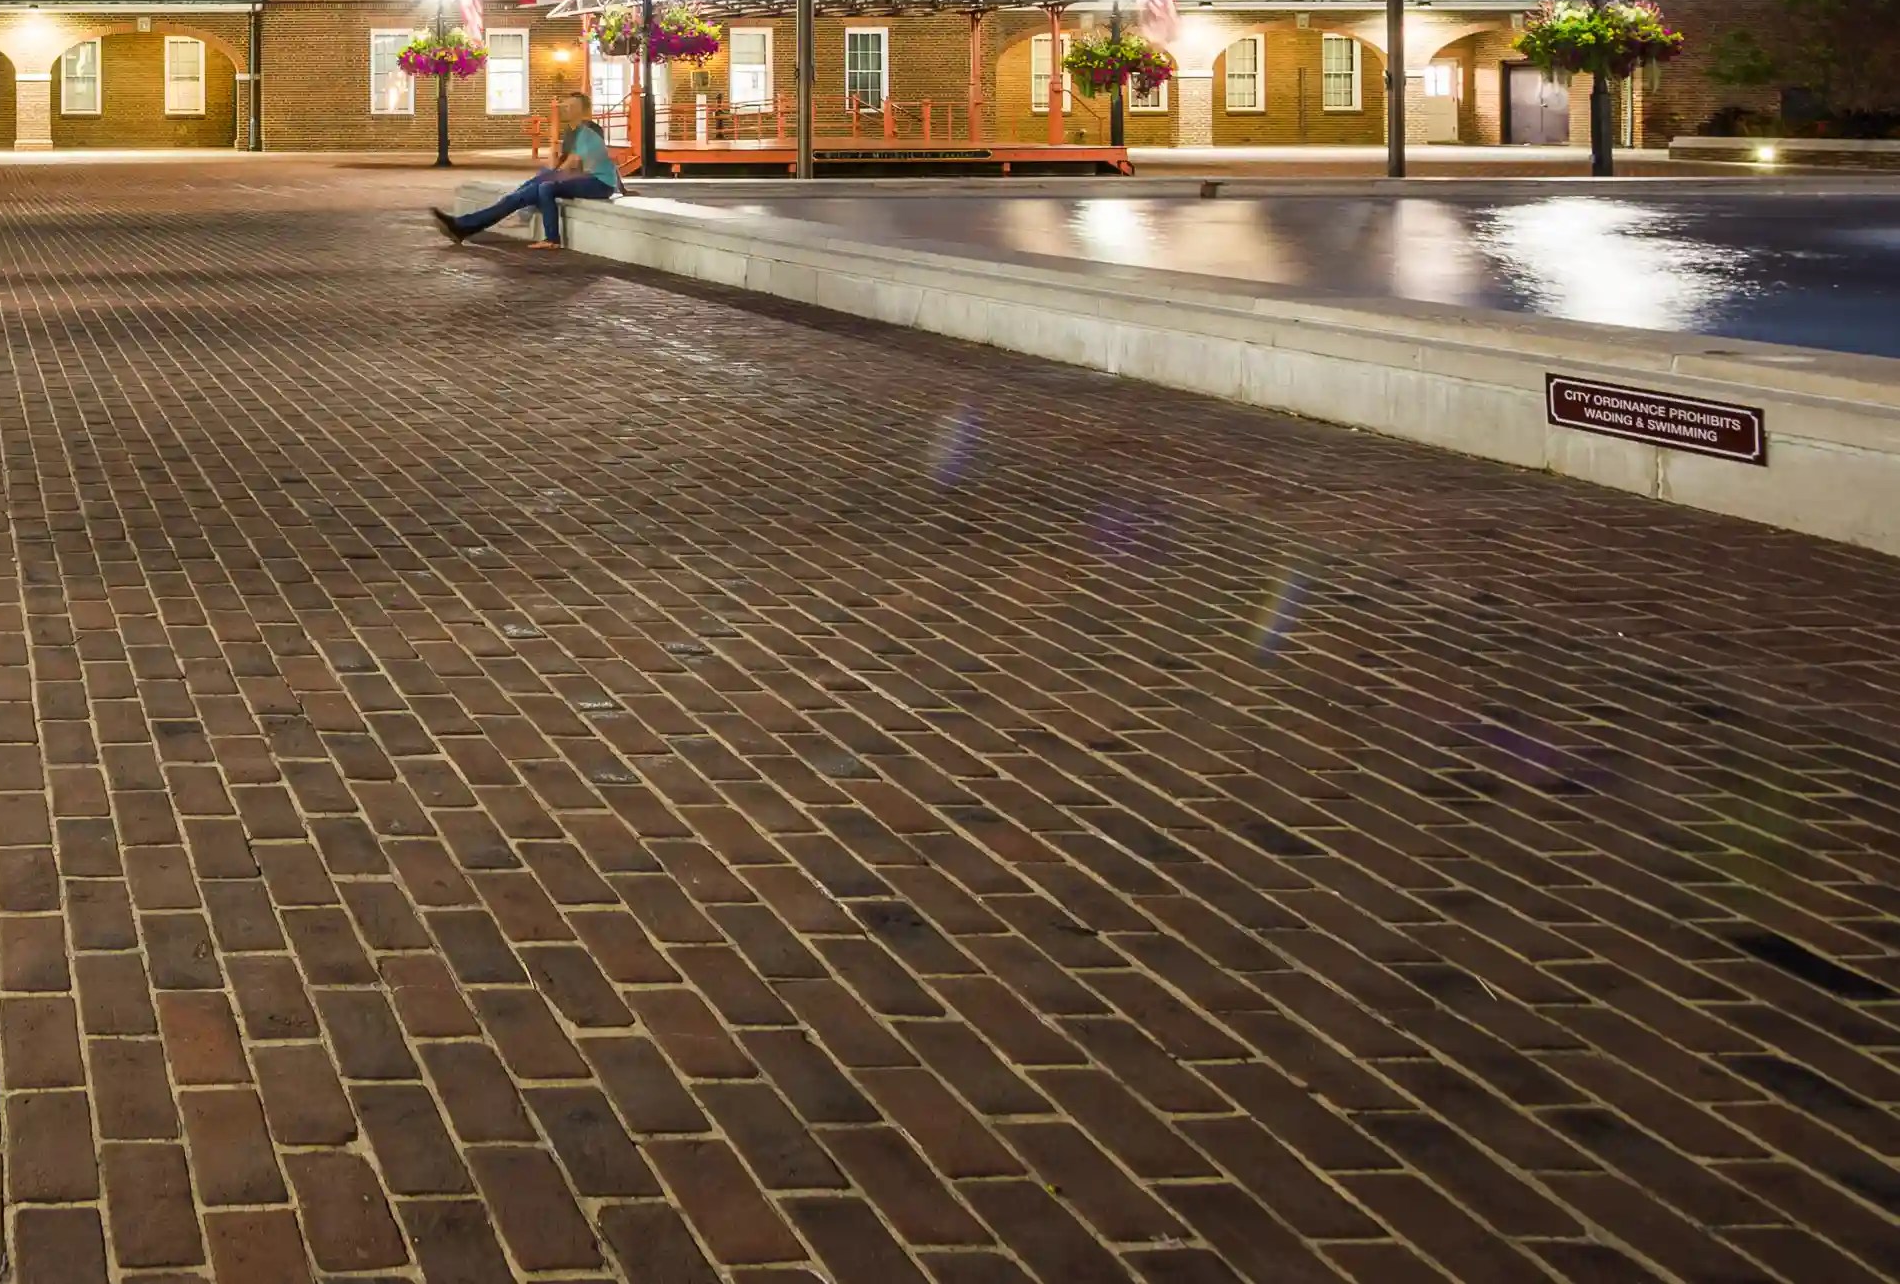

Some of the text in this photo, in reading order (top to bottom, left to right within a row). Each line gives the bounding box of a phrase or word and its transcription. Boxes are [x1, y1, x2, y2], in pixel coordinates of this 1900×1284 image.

[1564, 389, 1741, 431] CITY ORDINANCE PROHIBITS
[1584, 407, 1718, 442] WADING & SWIMMING
